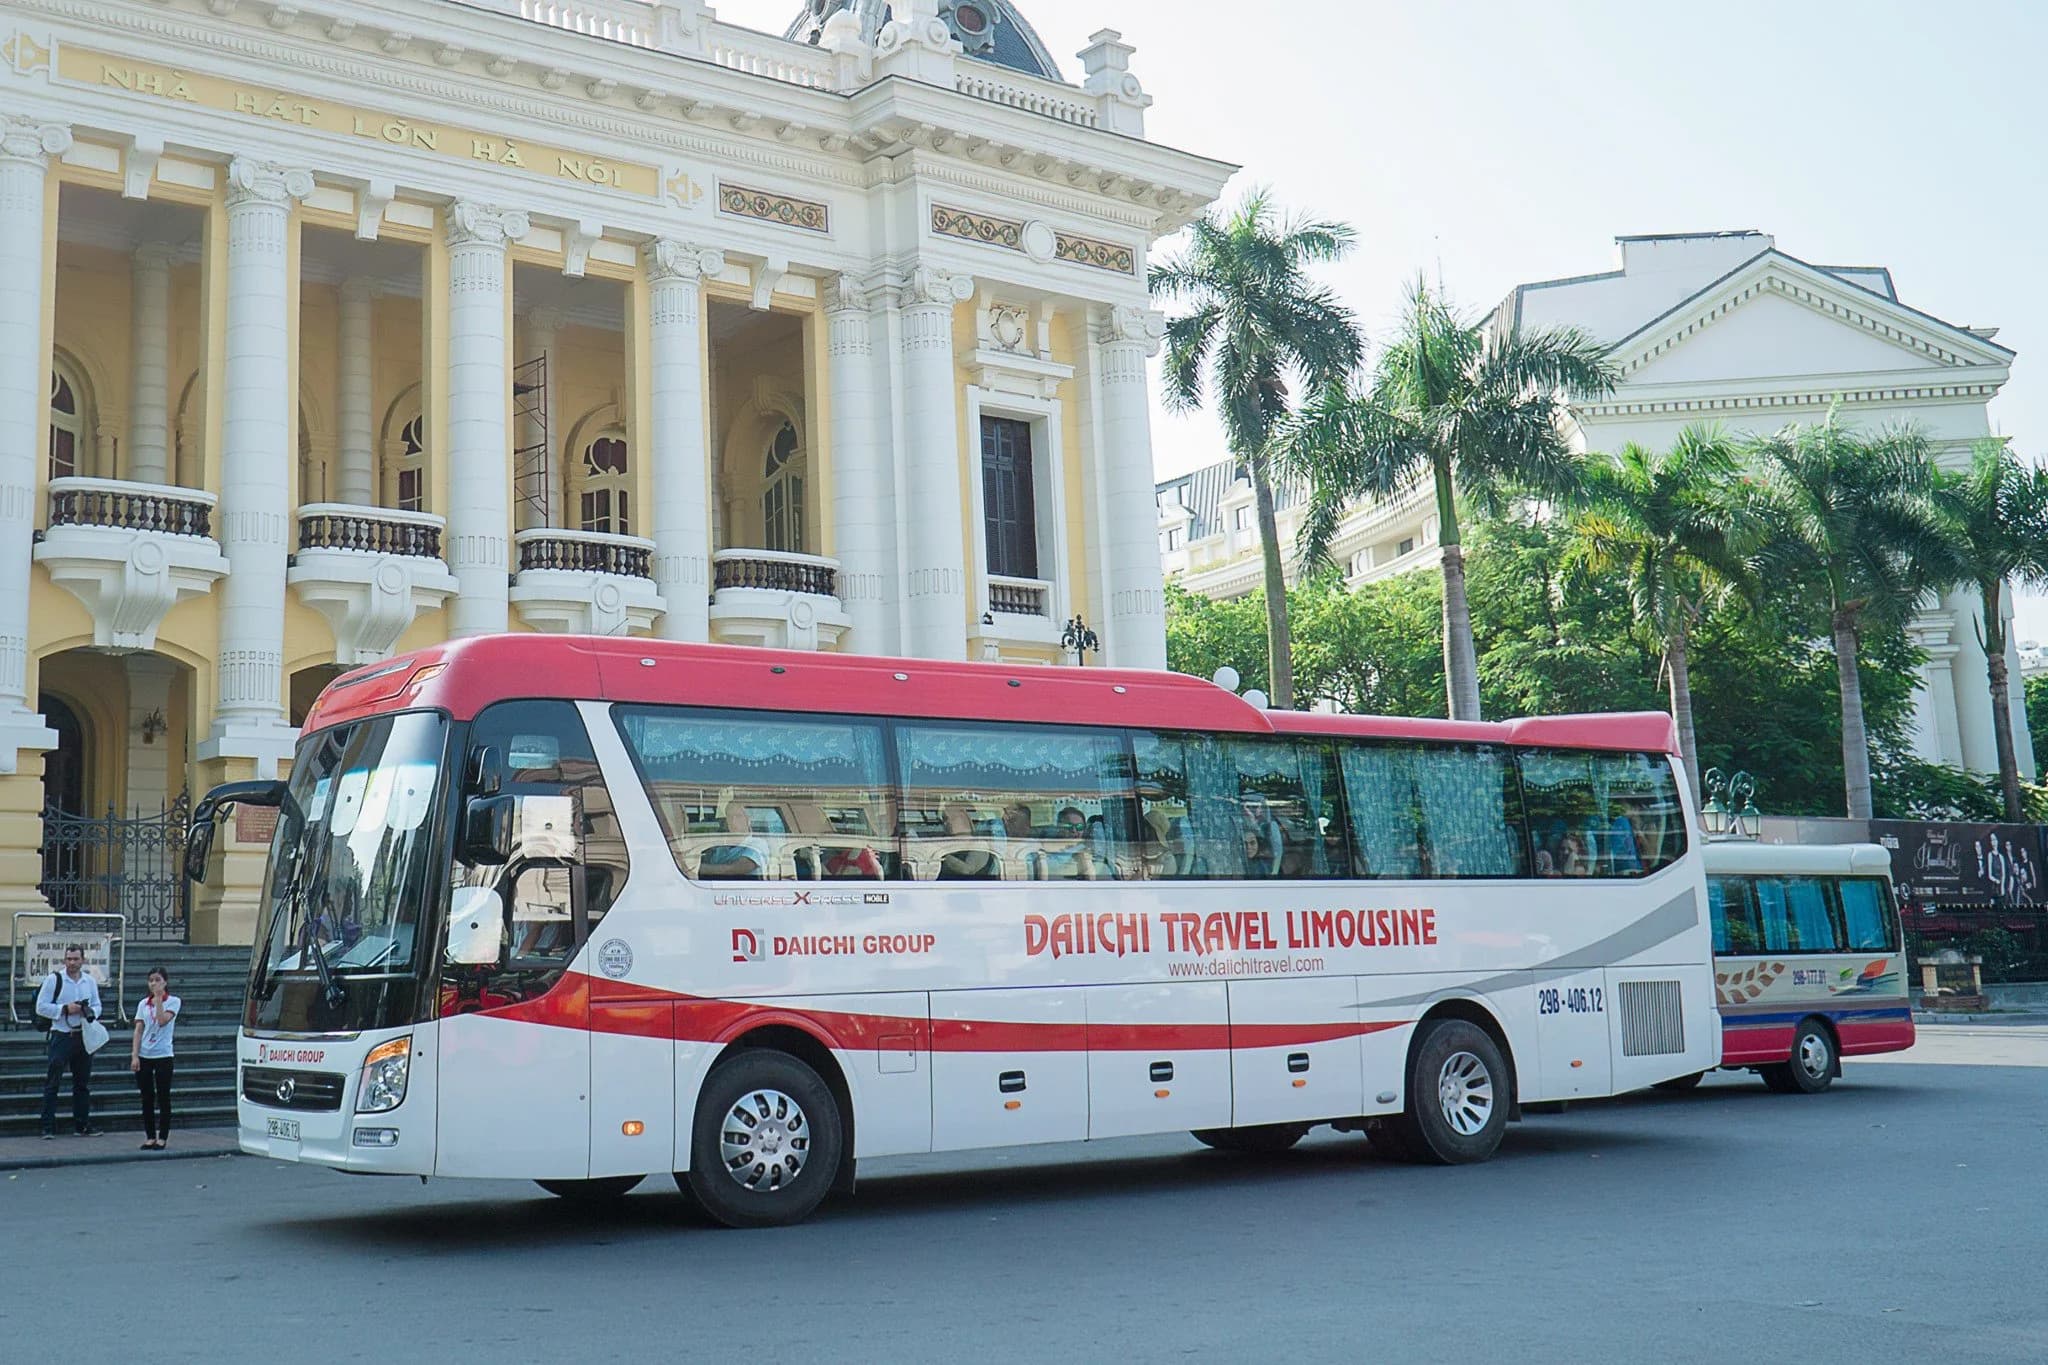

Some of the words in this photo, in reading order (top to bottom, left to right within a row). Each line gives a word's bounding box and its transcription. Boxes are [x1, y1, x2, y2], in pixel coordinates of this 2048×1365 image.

[102, 66, 198, 103] NHÀ
[234, 91, 320, 125] HÁT
[471, 138, 526, 168] HÀ
[864, 893, 889, 904] NOBLE
[773, 935, 856, 956] DAIICHI
[862, 934, 935, 954] GROUP
[1024, 912, 1150, 960] DAIICHI
[1160, 911, 1278, 957] TRAVEL
[1286, 909, 1438, 949] LIMOUSINE
[269, 1049, 296, 1061] DAIICHI
[297, 1051, 325, 1064] GROUP
